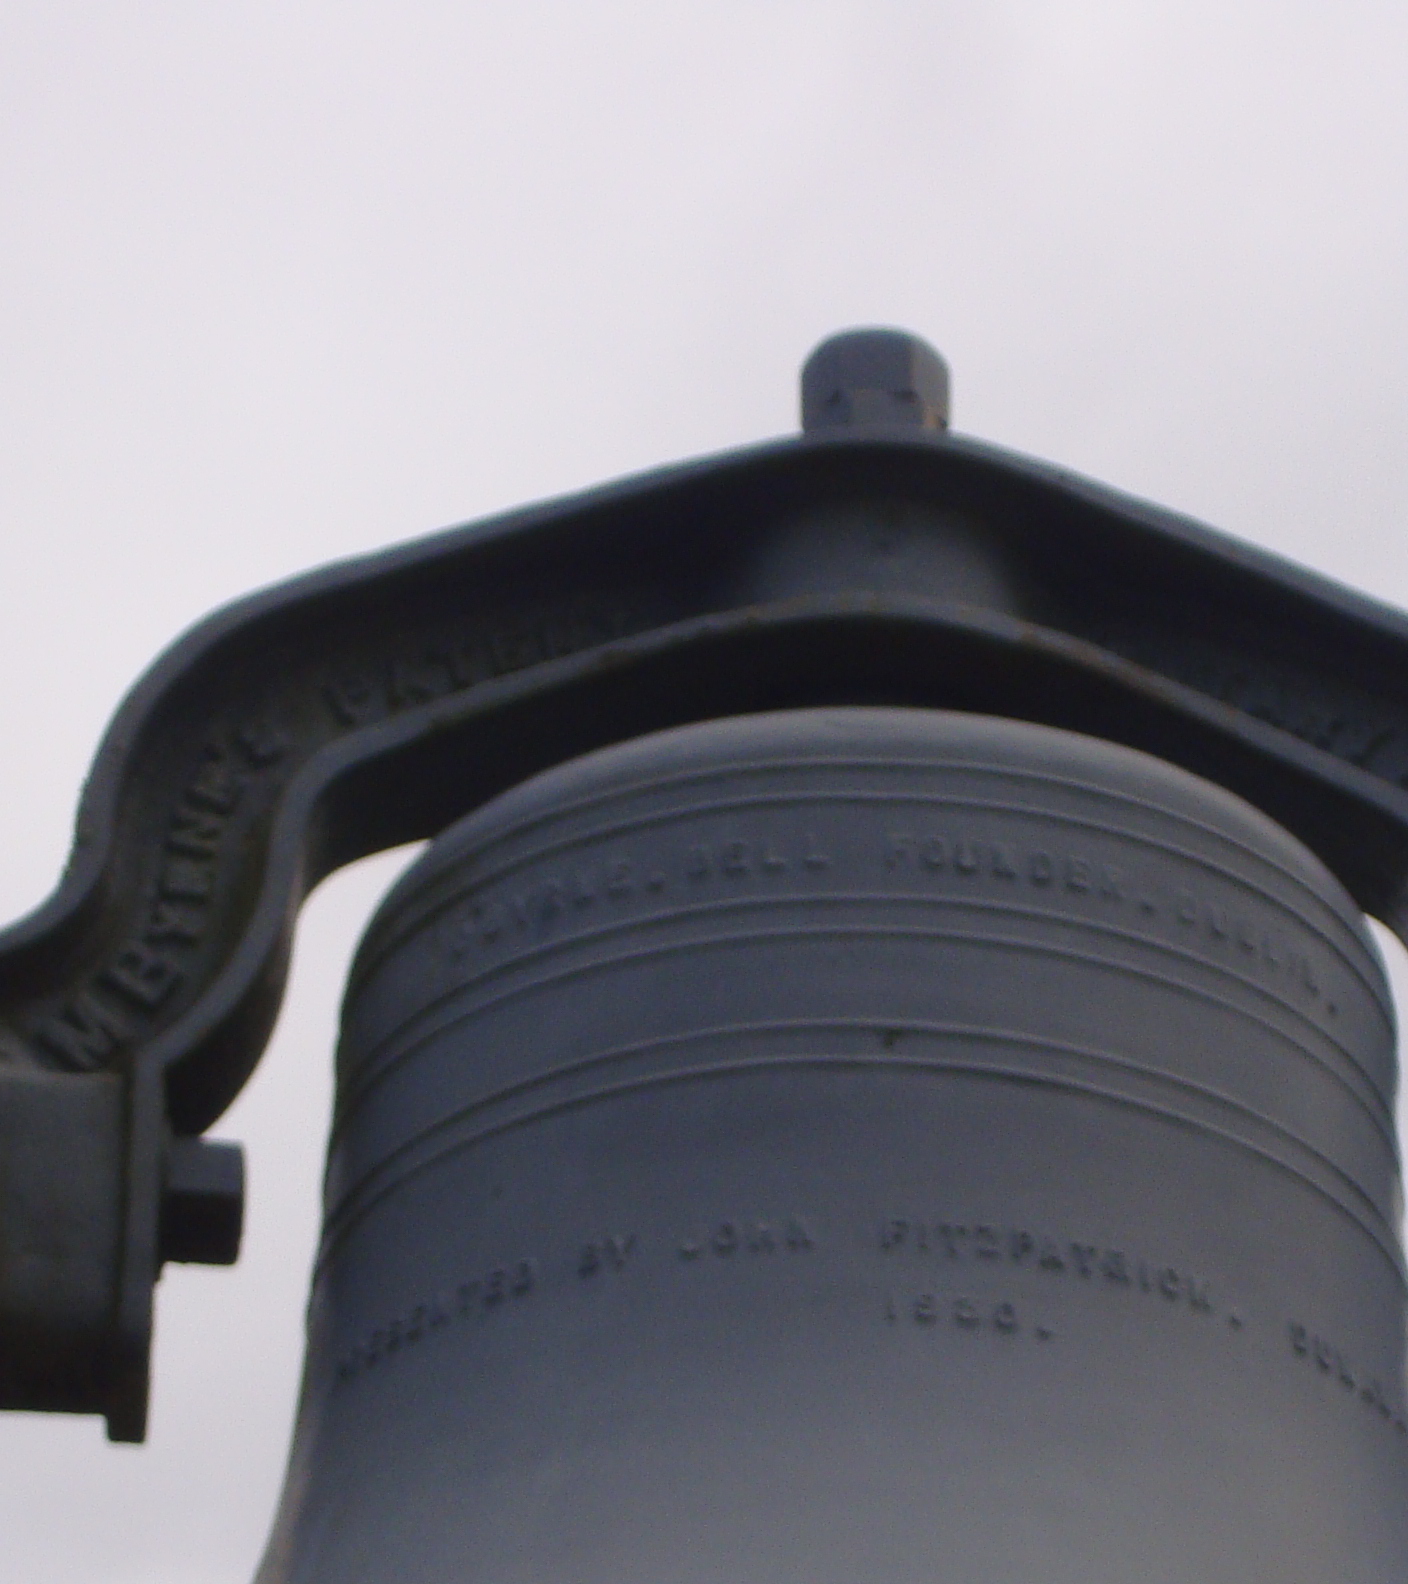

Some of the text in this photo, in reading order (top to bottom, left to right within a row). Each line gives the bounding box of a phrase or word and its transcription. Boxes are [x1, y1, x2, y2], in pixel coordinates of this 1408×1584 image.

[686, 832, 832, 881] BELL
[576, 1232, 638, 1282] BY
[676, 1218, 815, 1263] JOHN
